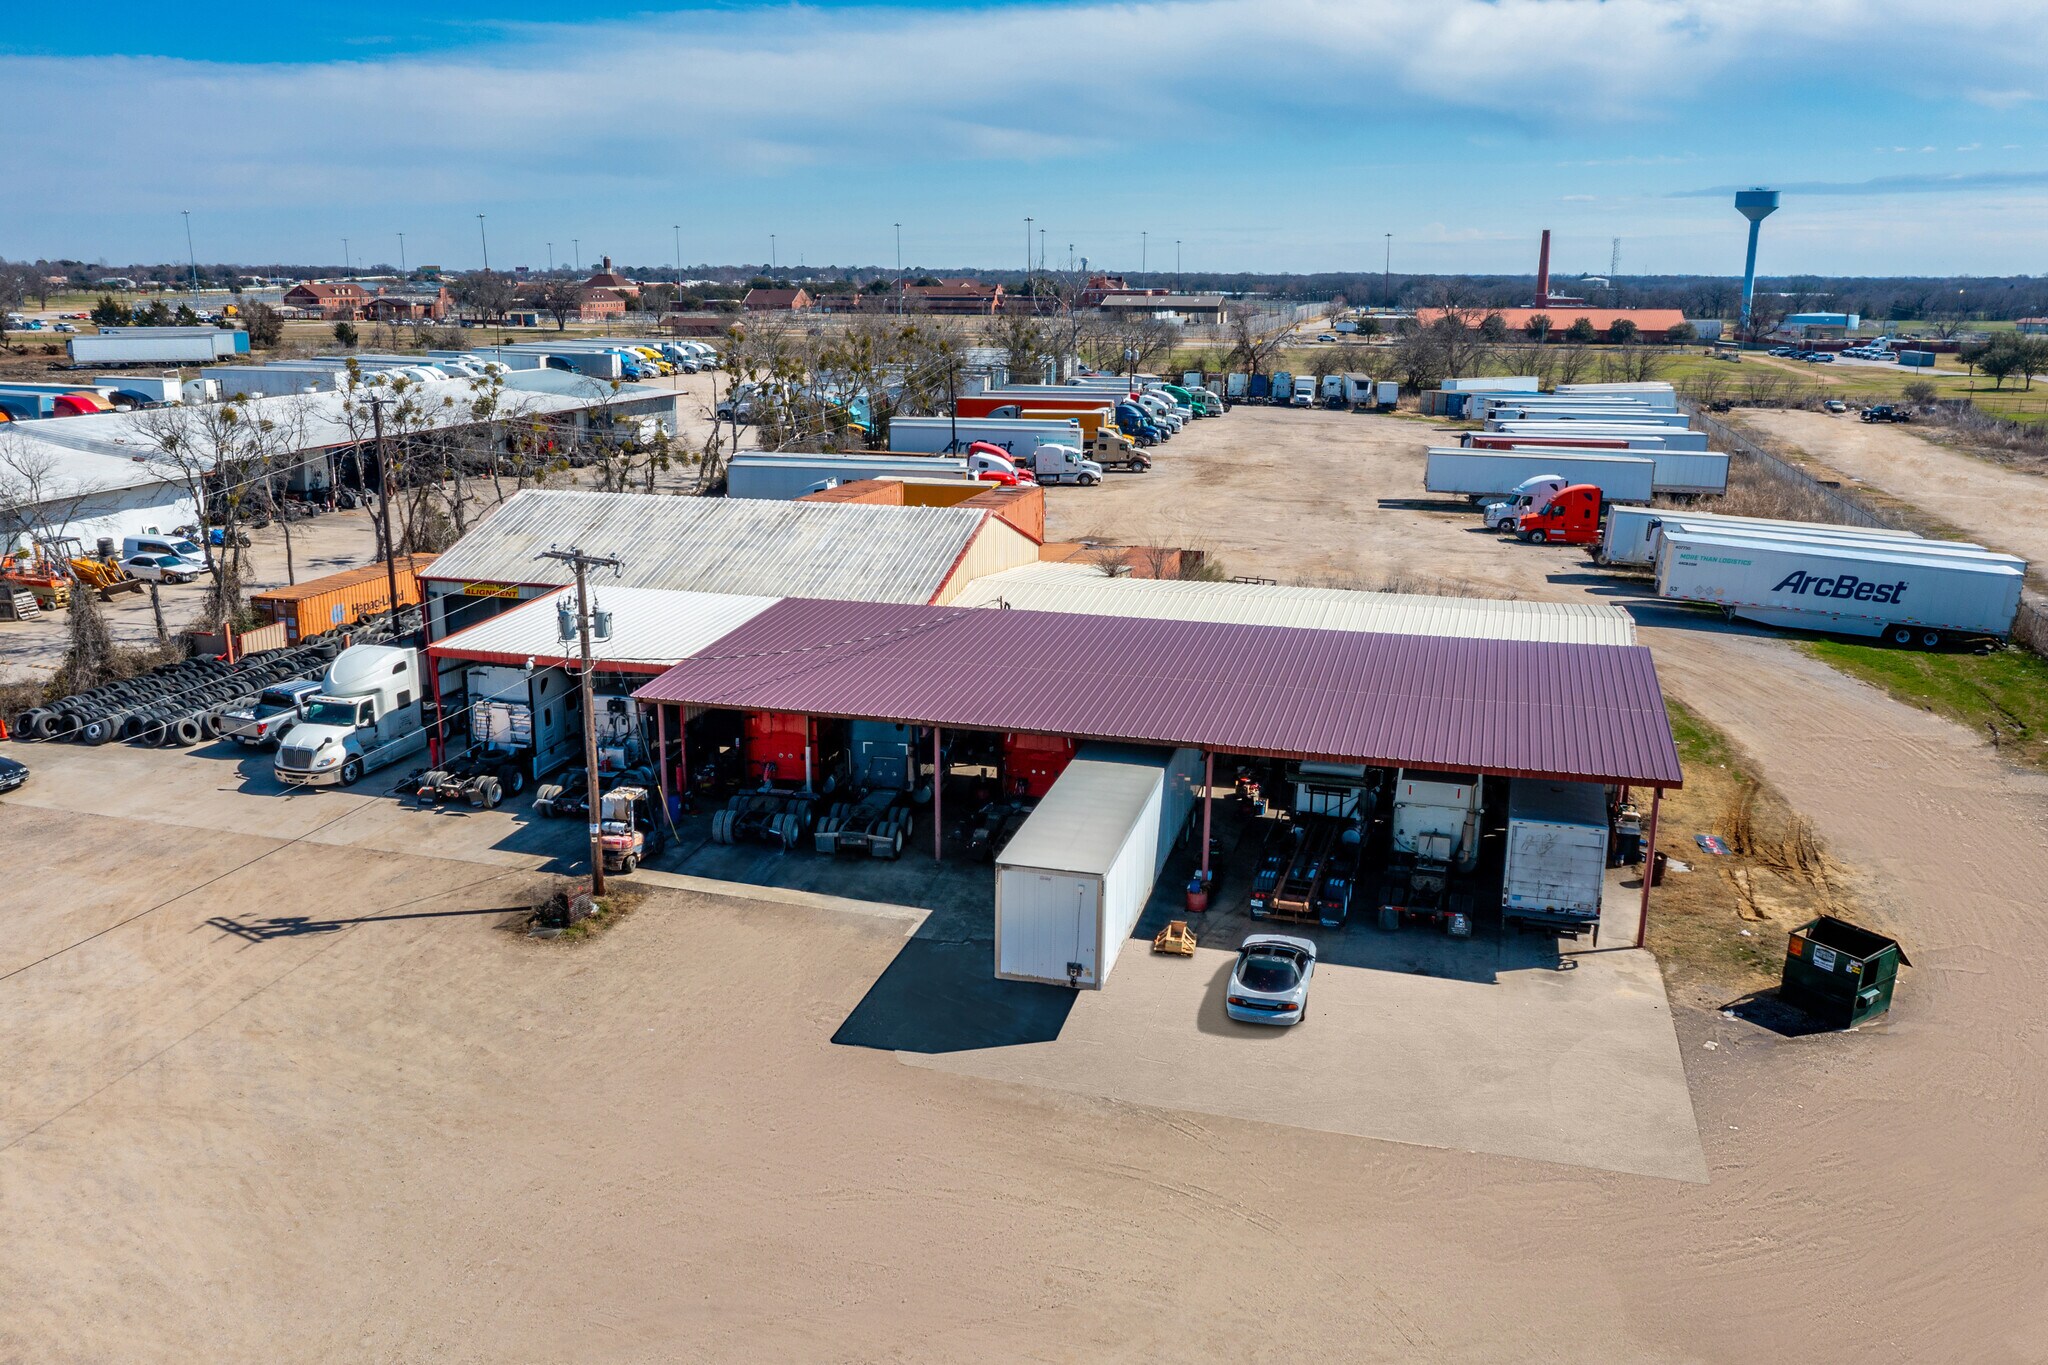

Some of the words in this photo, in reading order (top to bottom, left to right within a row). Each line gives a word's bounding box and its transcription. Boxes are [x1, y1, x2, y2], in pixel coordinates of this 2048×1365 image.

[1680, 553, 1698, 561] MORE
[1700, 555, 1718, 563] THAN
[1719, 558, 1752, 566] LOGISTICS
[465, 588, 518, 597] ALIGNMENT
[1771, 570, 1908, 604] ArcBest
[351, 589, 404, 616] Hapag-Lld
